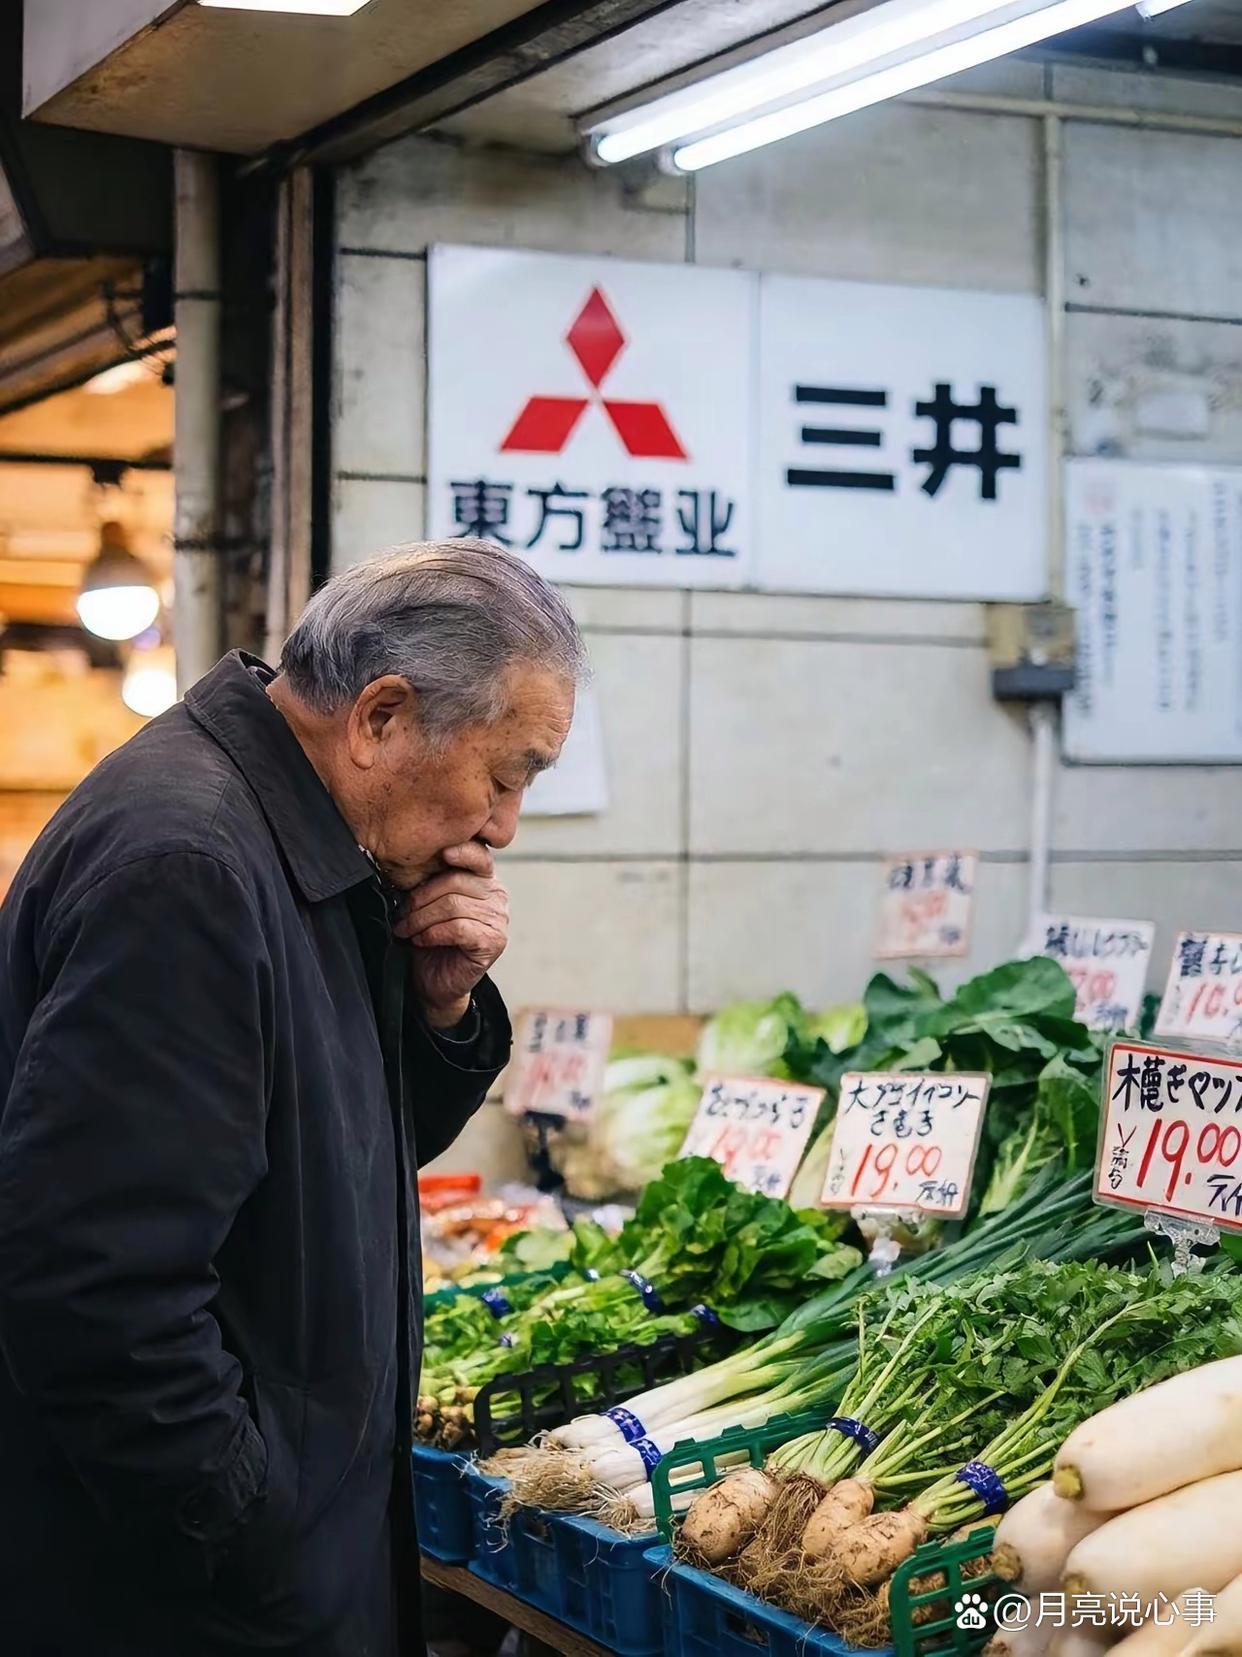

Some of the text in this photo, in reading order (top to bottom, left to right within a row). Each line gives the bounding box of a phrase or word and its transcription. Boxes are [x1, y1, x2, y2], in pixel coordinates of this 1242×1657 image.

[786, 381, 1021, 500] 三井
[849, 1143, 943, 1198] 19.00
[1136, 1118, 1241, 1202] 19.00
